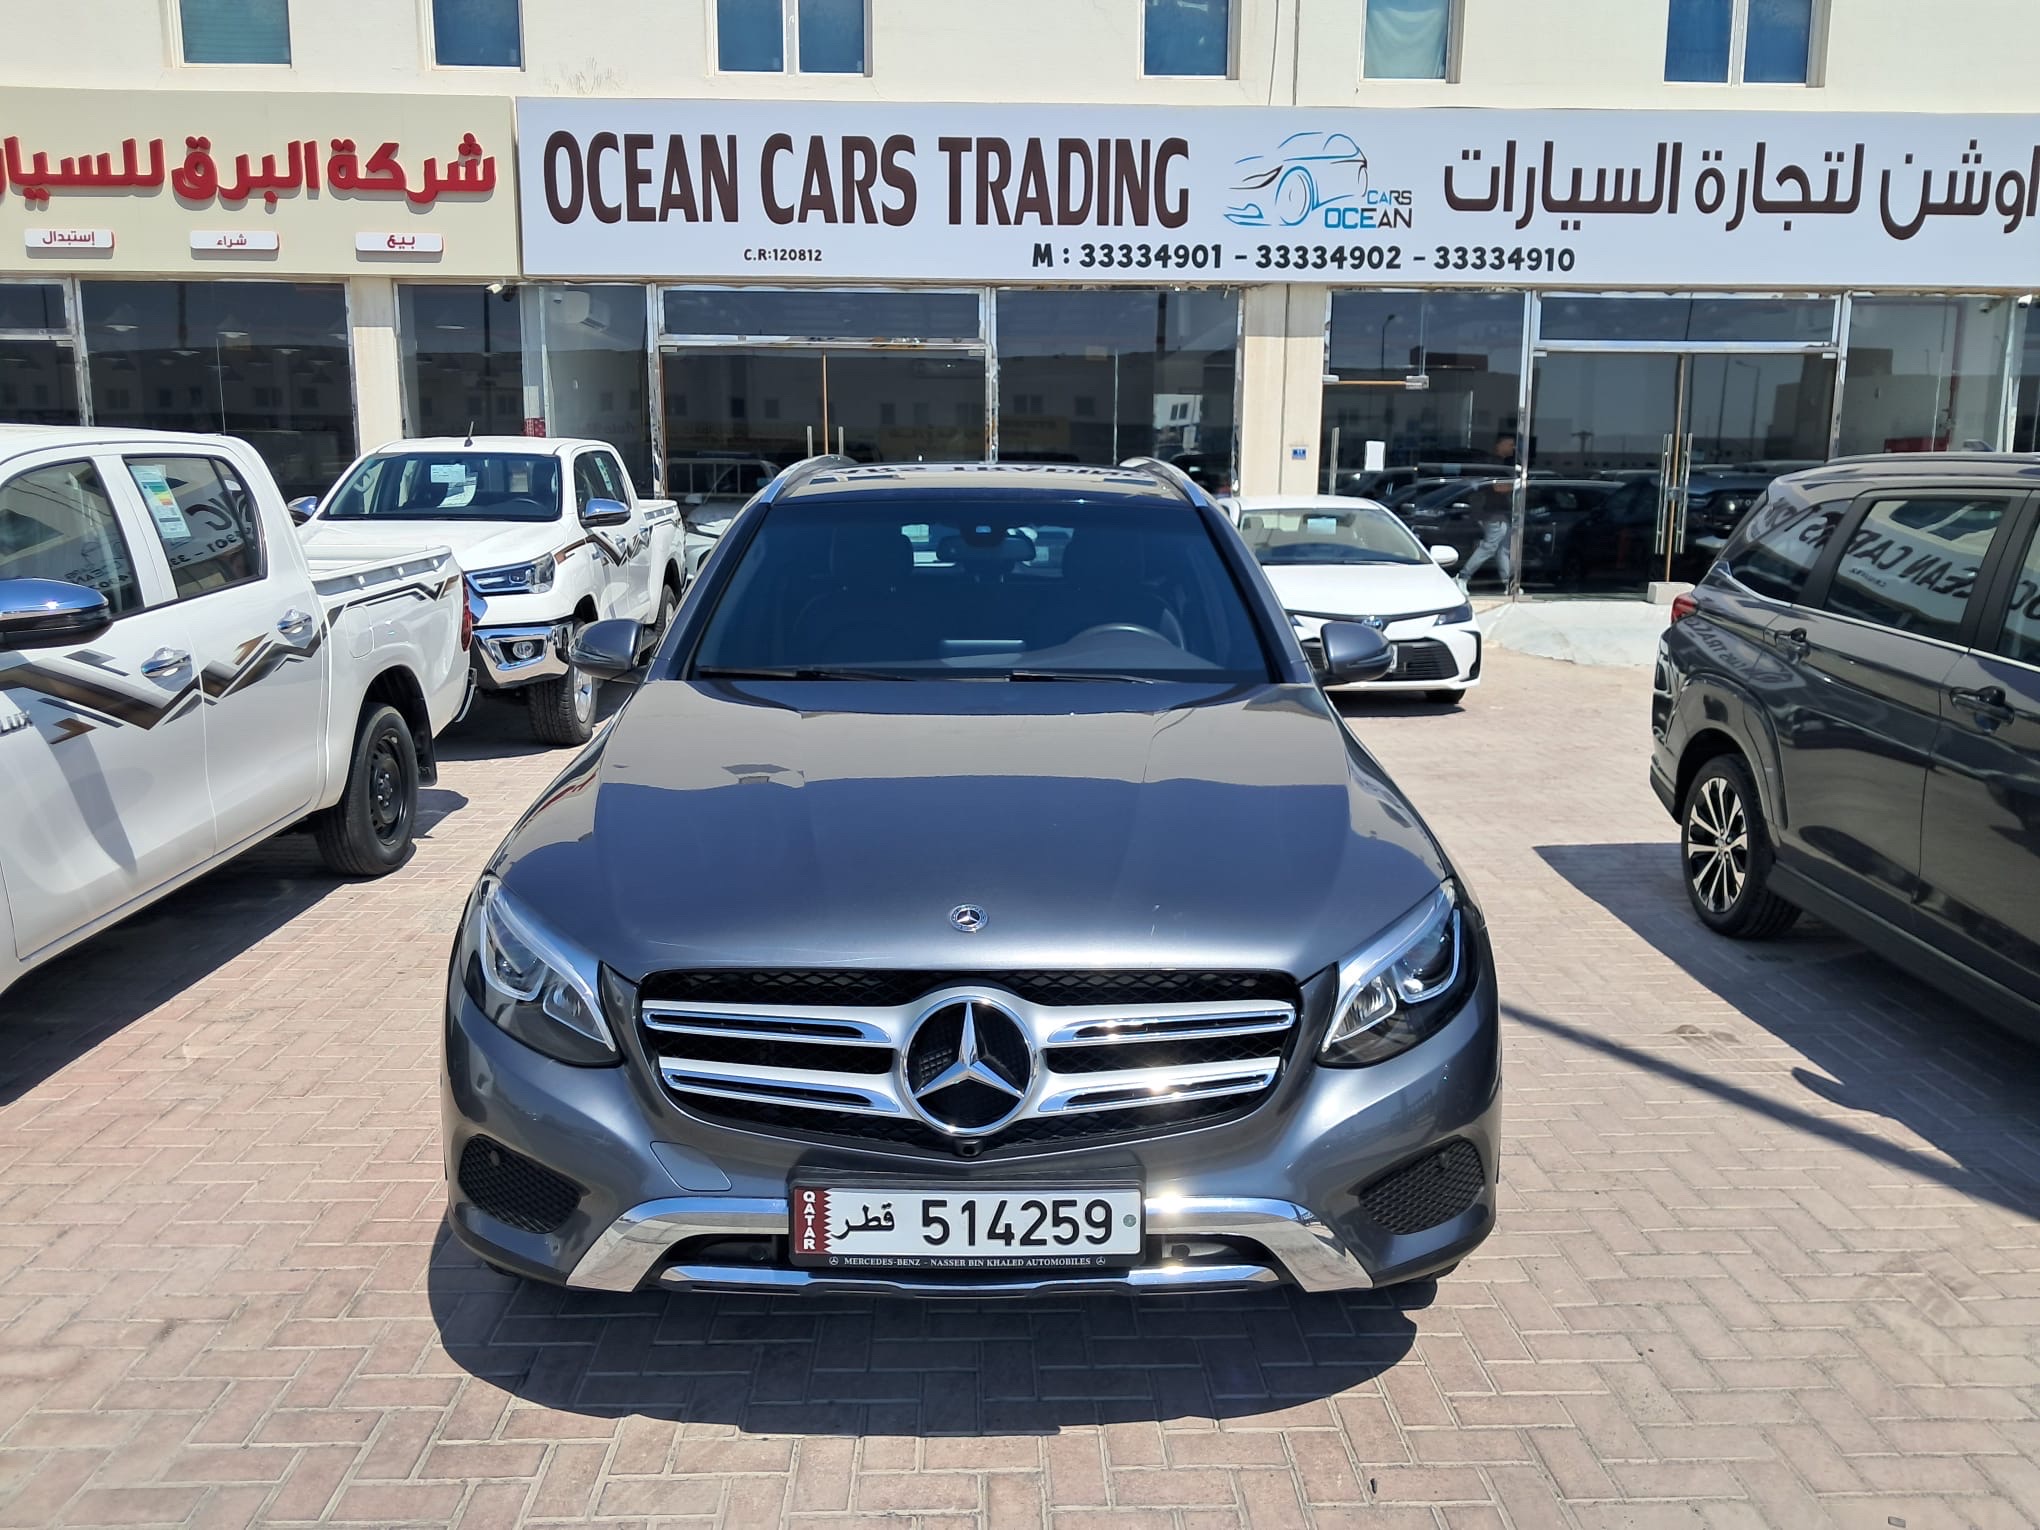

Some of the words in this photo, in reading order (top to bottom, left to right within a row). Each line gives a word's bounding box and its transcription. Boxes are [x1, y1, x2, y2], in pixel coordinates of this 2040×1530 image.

[171, 136, 320, 204] البرق
[328, 131, 497, 204] شركة
[543, 130, 739, 225] OCEAN
[760, 132, 918, 227] CARS
[938, 136, 1190, 229] TRADING
[1443, 139, 1683, 231] السيارات
[1694, 141, 1866, 232] لتجارة
[1366, 189, 1413, 206] CARS
[1879, 139, 2040, 241] اوشن
[1324, 207, 1413, 230] OCEAN
[216, 233, 247, 248] شراء
[386, 234, 416, 249] بيع
[743, 248, 823, 262] C.R:120812
[1079, 243, 1222, 269] 33334901
[1255, 244, 1402, 270] 33334902
[1433, 245, 1575, 272] 33334910
[803, 1190, 816, 1250] QATAR
[832, 1203, 895, 1239] قطر
[921, 1199, 1113, 1247] 514259
[844, 1257, 921, 1266] MERCEDES-BENZ
[930, 1259, 966, 1267] NASSER
[968, 1259, 984, 1267] BIN
[986, 1259, 1024, 1267] KHALED
[1026, 1258, 1091, 1267] AUTOMOBILES
